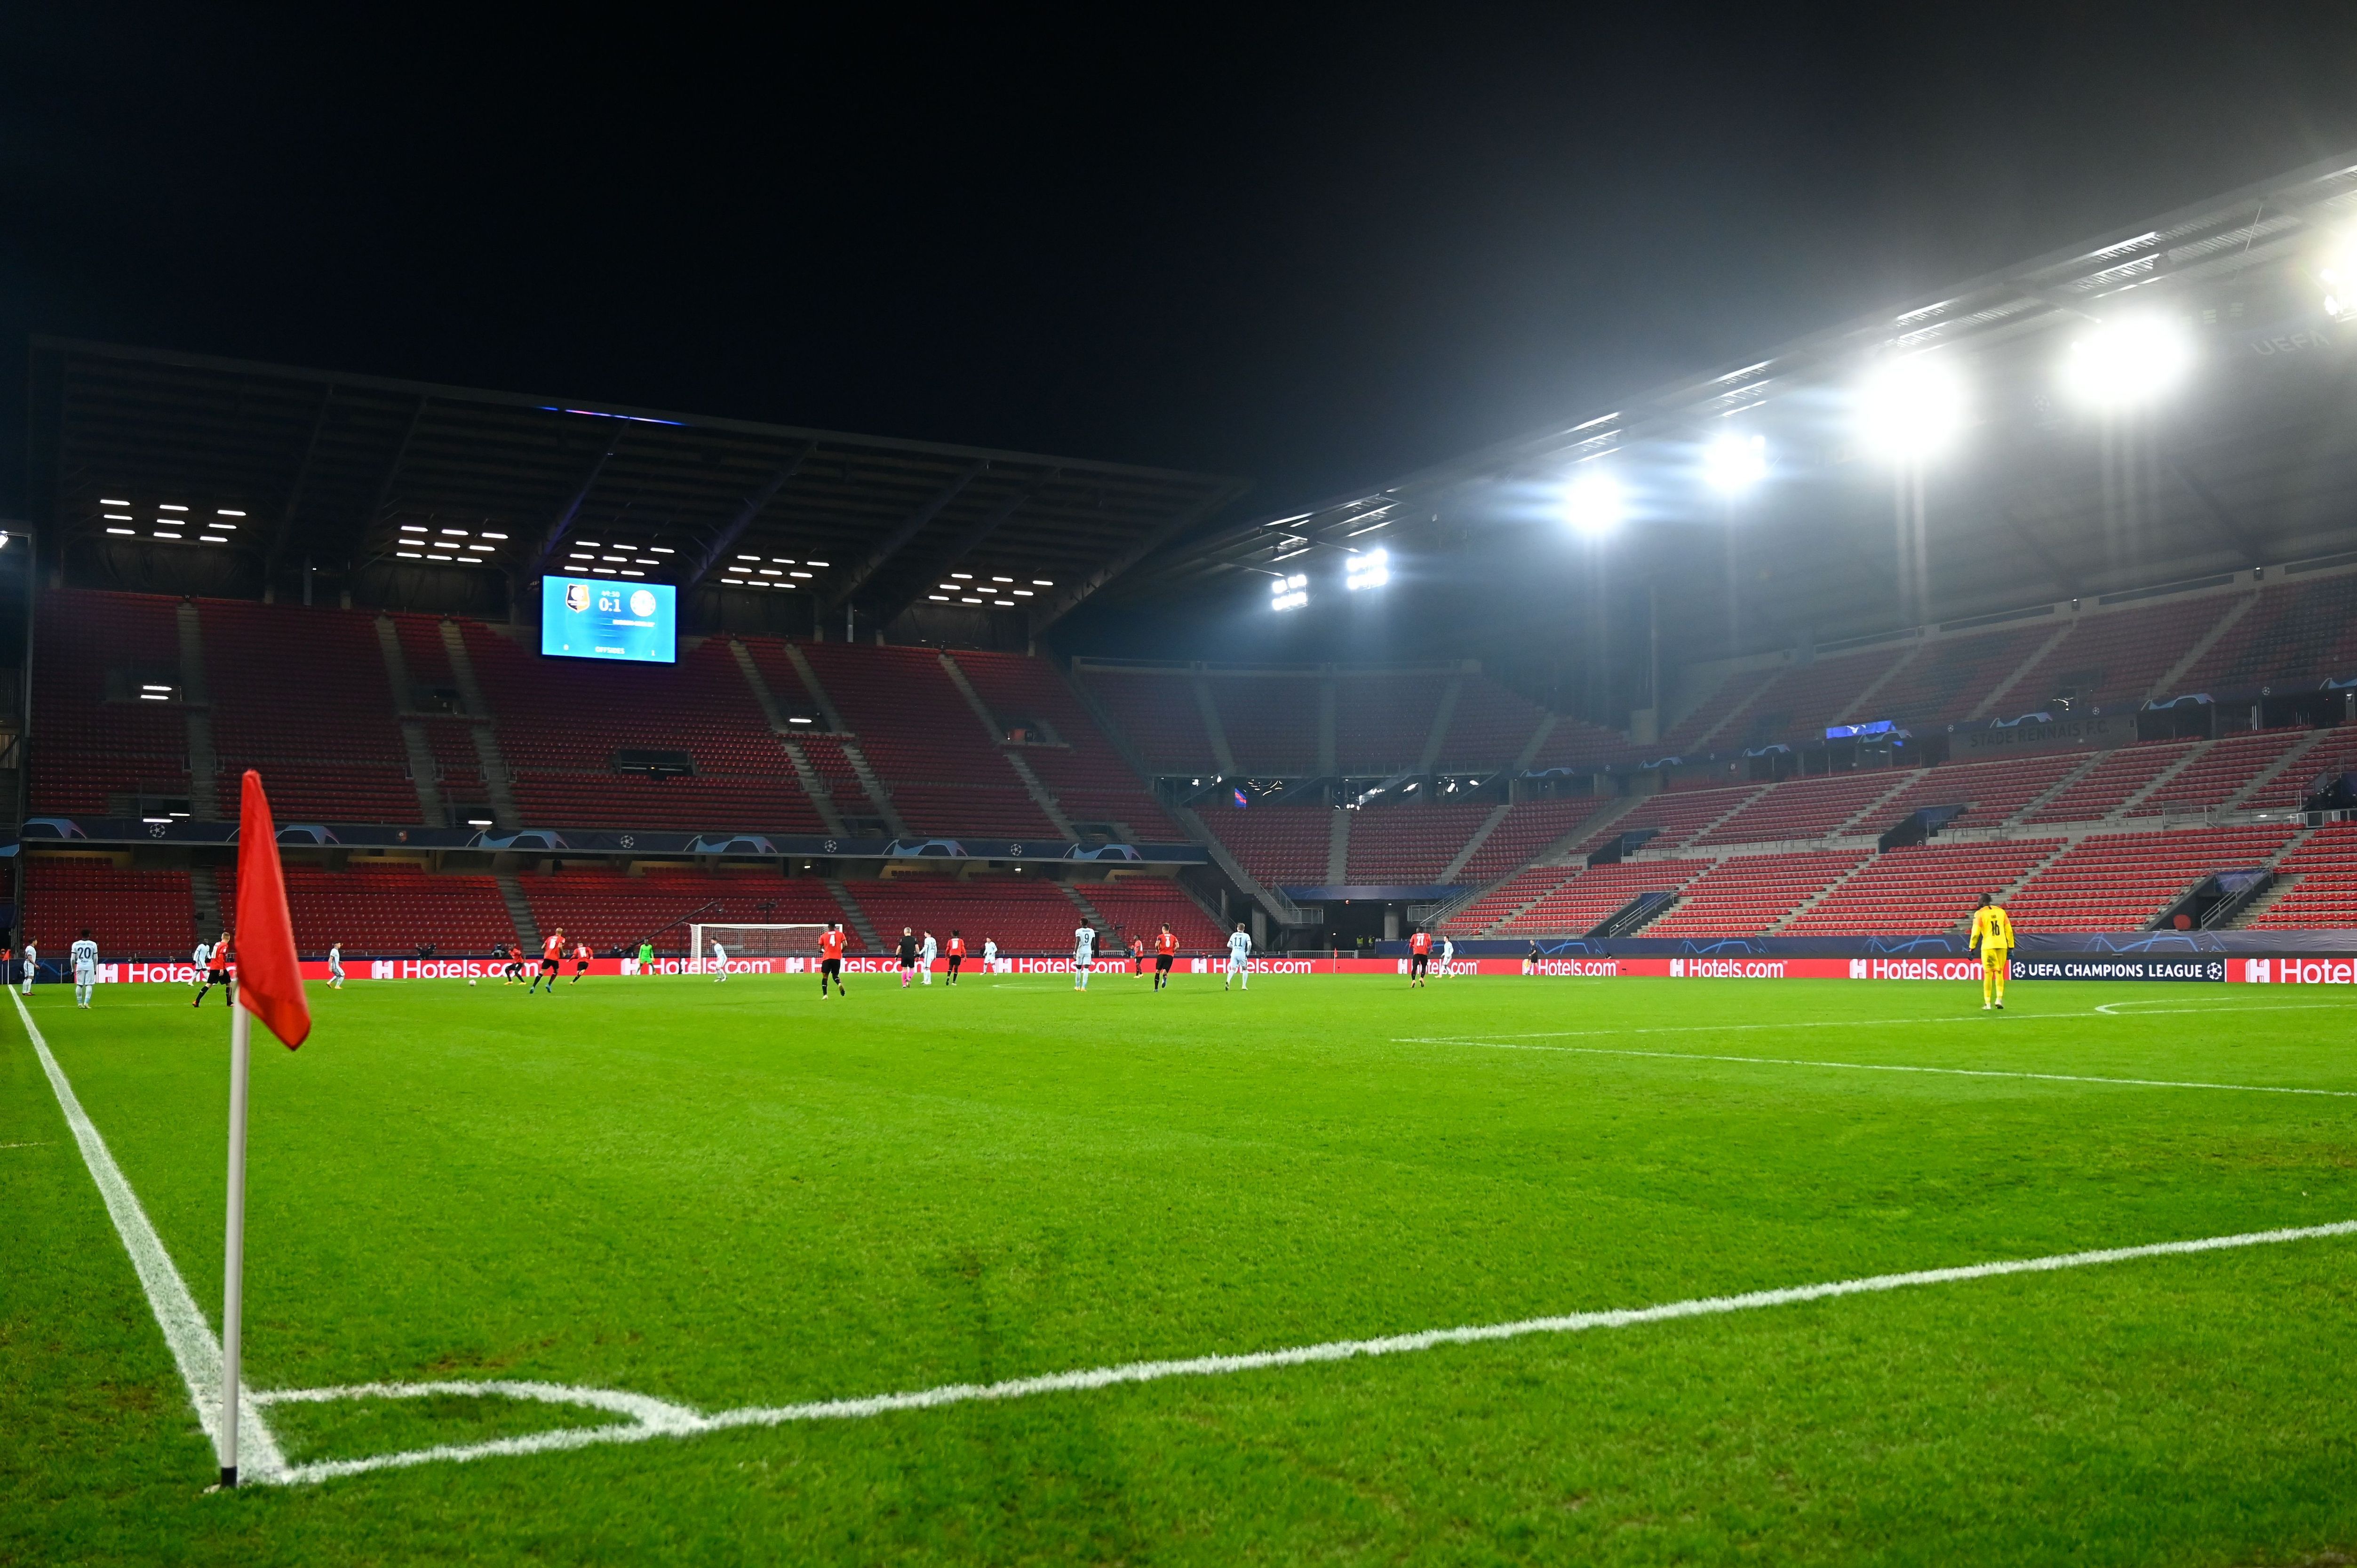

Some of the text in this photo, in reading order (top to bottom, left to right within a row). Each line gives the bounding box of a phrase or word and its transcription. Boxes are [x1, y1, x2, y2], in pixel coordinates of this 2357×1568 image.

[2250, 330, 2330, 355] UEFA
[598, 597, 621, 612] 0:1
[595, 646, 625, 654] OFFSIDES
[1971, 720, 2110, 747] STADE RENNAIS F.C.
[1991, 920, 2000, 936] 16
[829, 935, 836, 947] 4
[1084, 933, 1089, 943] 9
[1234, 937, 1242, 947] 11
[78, 947, 91, 959] 20
[649, 957, 771, 975] Hotelscom
[811, 957, 924, 973] Htels.com
[1019, 958, 1125, 973] Hotelscom
[1411, 958, 1477, 975] otelcom
[1538, 958, 1616, 977] Hotels.com
[1689, 958, 1784, 978] Hotels.com
[1873, 958, 1984, 980] Hotels.com
[2028, 963, 2203, 978] UEFA CHAMPIONS LEAGUE
[2280, 958, 2357, 984] Hotel
